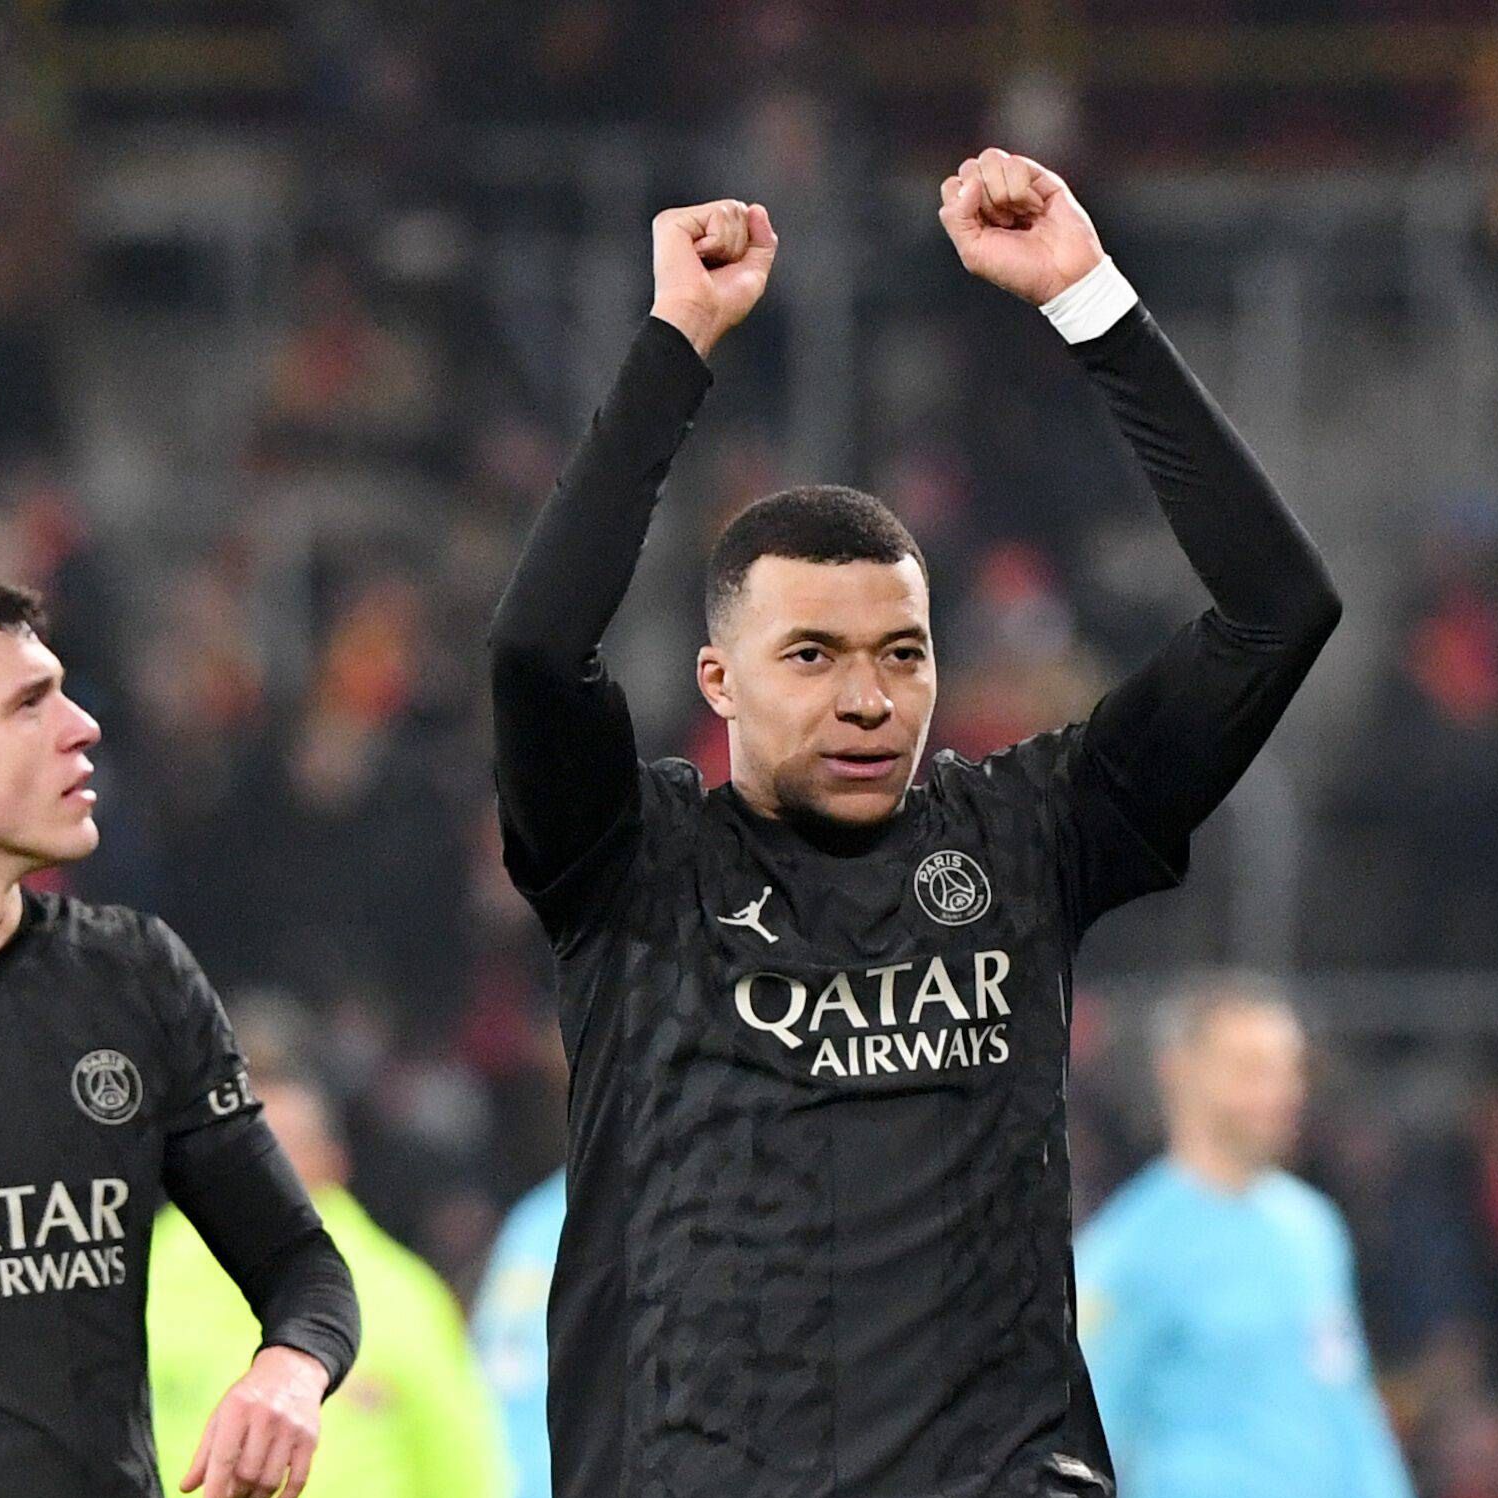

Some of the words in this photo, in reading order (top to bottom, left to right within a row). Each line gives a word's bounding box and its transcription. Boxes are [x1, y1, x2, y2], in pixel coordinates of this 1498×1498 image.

[919, 855, 962, 883] PARIS
[734, 949, 1012, 1049] QATAR
[810, 1023, 1010, 1076] AIRWAYS
